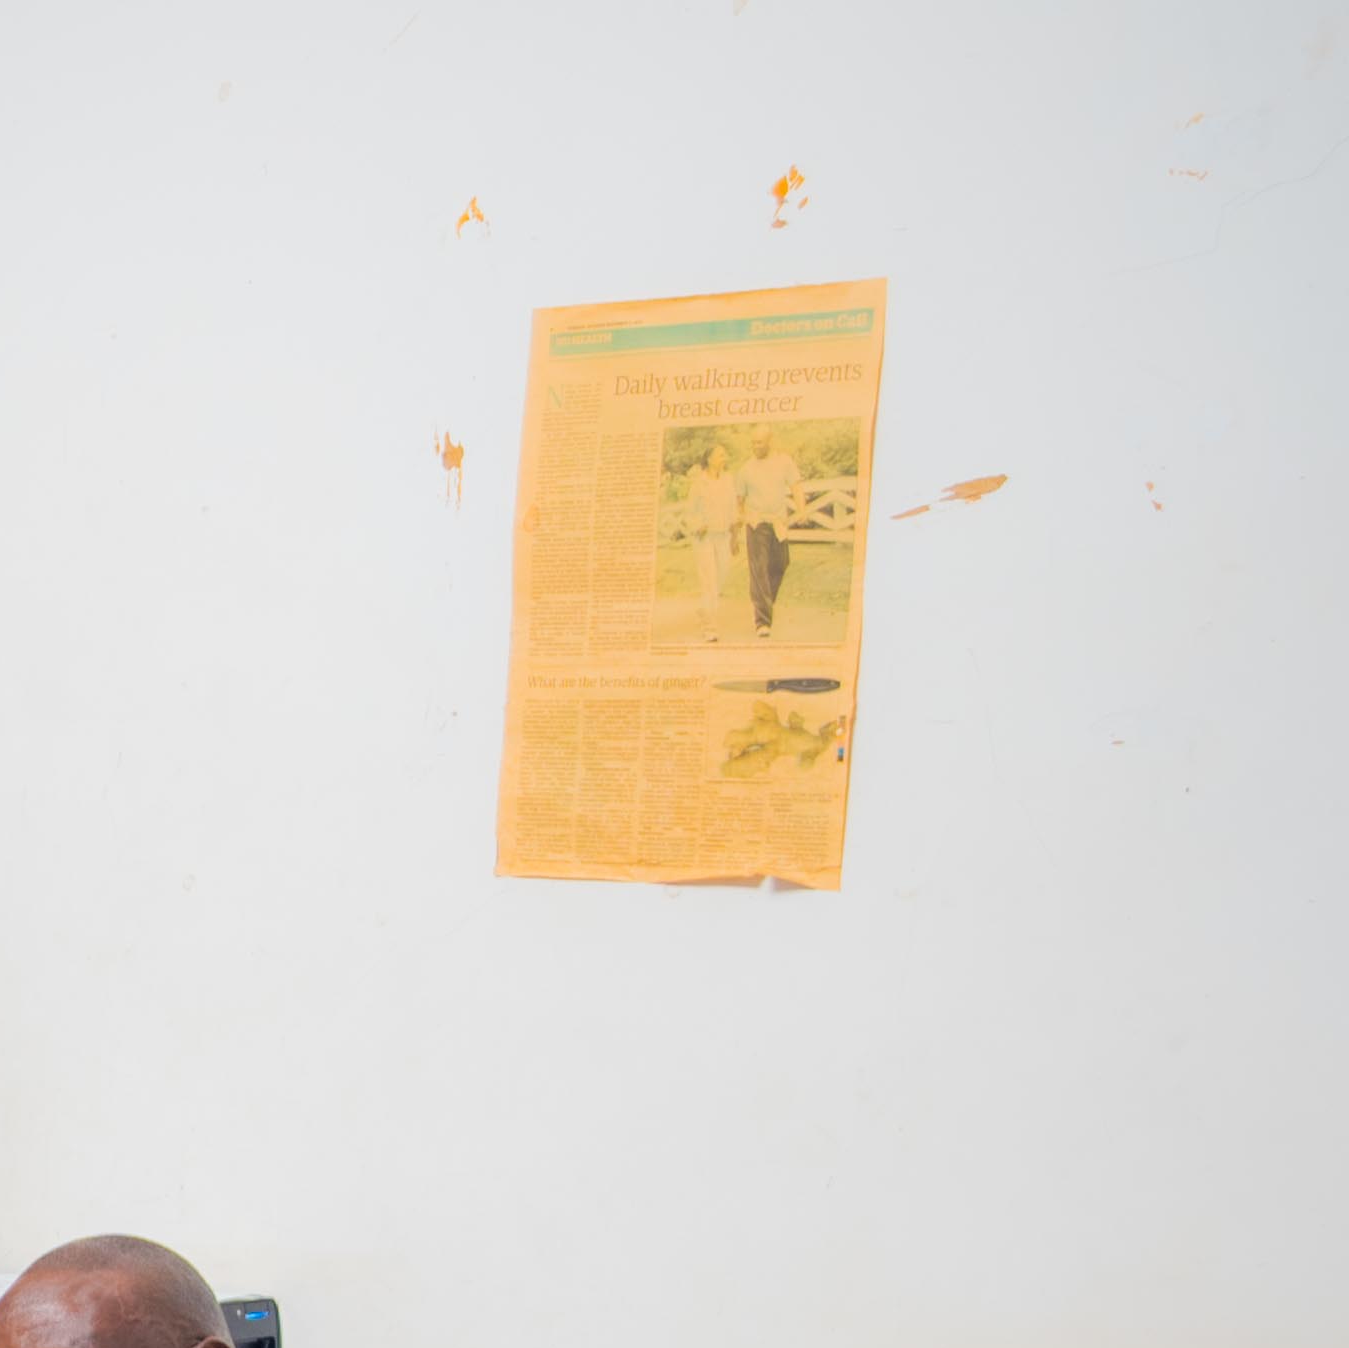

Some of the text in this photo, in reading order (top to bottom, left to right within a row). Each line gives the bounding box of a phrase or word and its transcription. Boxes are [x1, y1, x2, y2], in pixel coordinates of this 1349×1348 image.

[753, 319, 812, 335] Doctors
[836, 312, 869, 329] Call
[614, 362, 862, 397] Daily walking prevents
[658, 393, 803, 420] breast cancer
